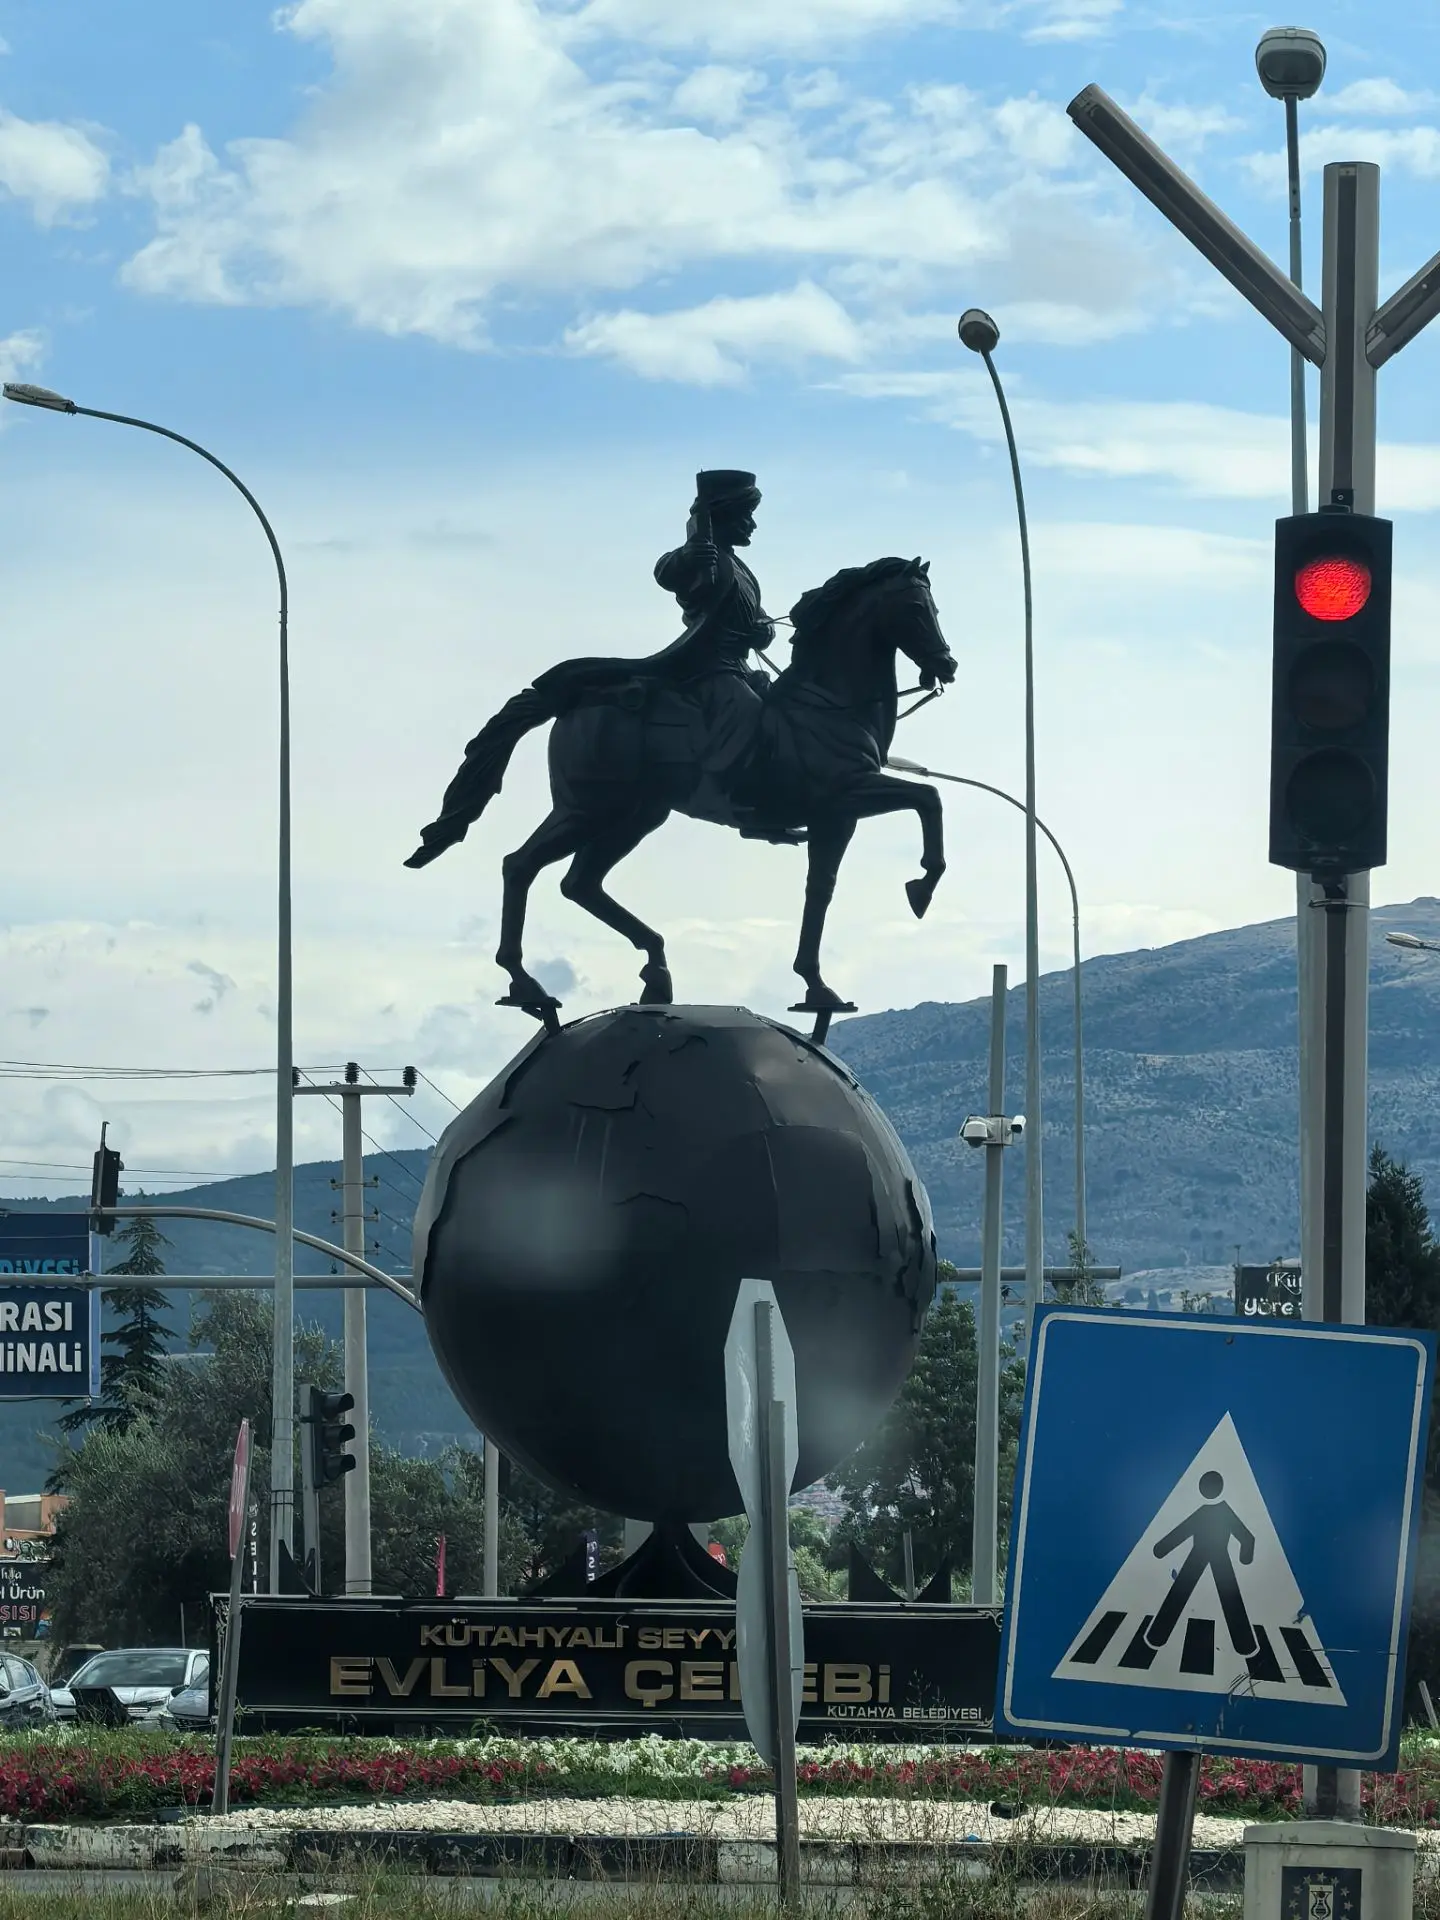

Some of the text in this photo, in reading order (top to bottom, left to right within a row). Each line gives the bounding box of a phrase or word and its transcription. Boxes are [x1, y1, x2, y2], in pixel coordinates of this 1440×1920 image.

[0, 1301, 73, 1332] RASI
[0, 1342, 82, 1373] İNALİ
[10, 1583, 45, 1600] Ürün
[637, 1627, 736, 1649] SEYY
[624, 1660, 891, 1708] ÇEBİ
[827, 1704, 896, 1718] KÜTAHYA
